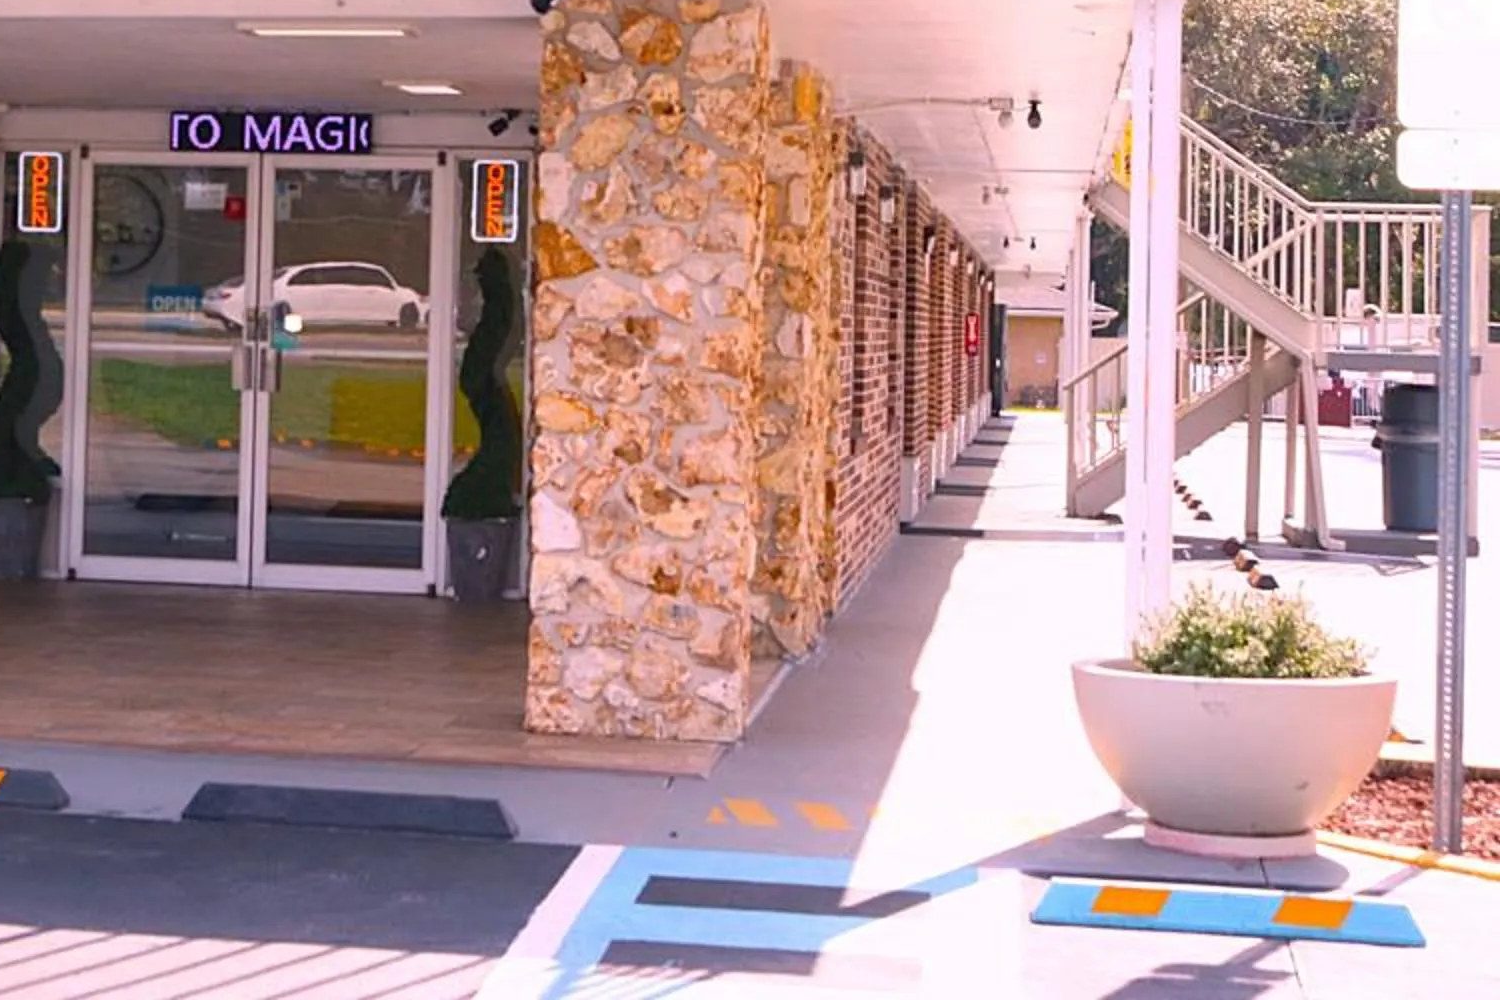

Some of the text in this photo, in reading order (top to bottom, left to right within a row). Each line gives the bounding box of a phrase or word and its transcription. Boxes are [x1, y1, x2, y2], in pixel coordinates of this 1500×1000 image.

[32, 155, 49, 228] OPEN
[487, 164, 505, 237] OPEN
[151, 295, 197, 312] OPEN
